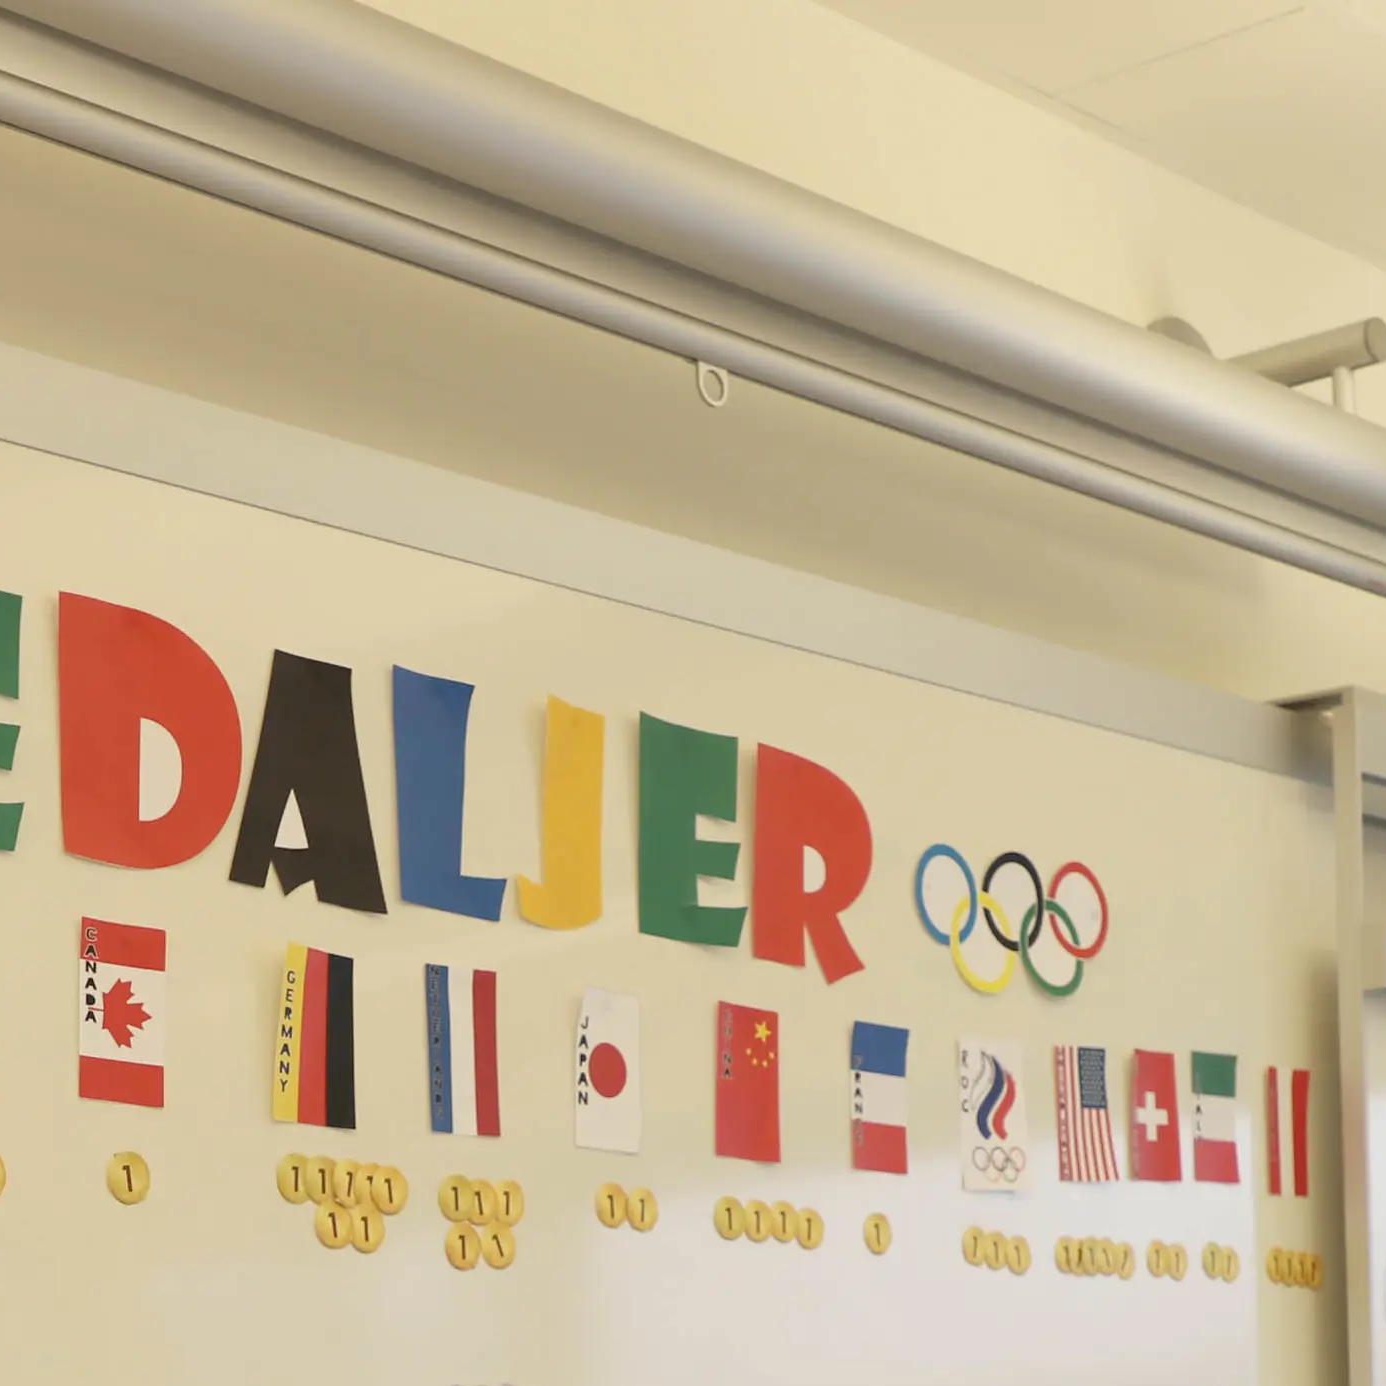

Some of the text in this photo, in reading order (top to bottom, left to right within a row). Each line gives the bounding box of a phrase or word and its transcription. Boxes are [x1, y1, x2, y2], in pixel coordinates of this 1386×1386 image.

[83, 926, 99, 1025] CANADA
[279, 968, 298, 1095] GERMANY
[577, 1015, 591, 1107] JAPAN
[120, 1163, 134, 1194] 1
[290, 1164, 395, 1205] 1 1 1 1
[450, 1185, 511, 1217] 1 1 1
[606, 1193, 646, 1224] 1 1
[327, 1210, 371, 1244] 1 1
[723, 1205, 813, 1242] 1 1 1 1
[872, 1221, 882, 1247] 1
[457, 1232, 505, 1262] 1 1
